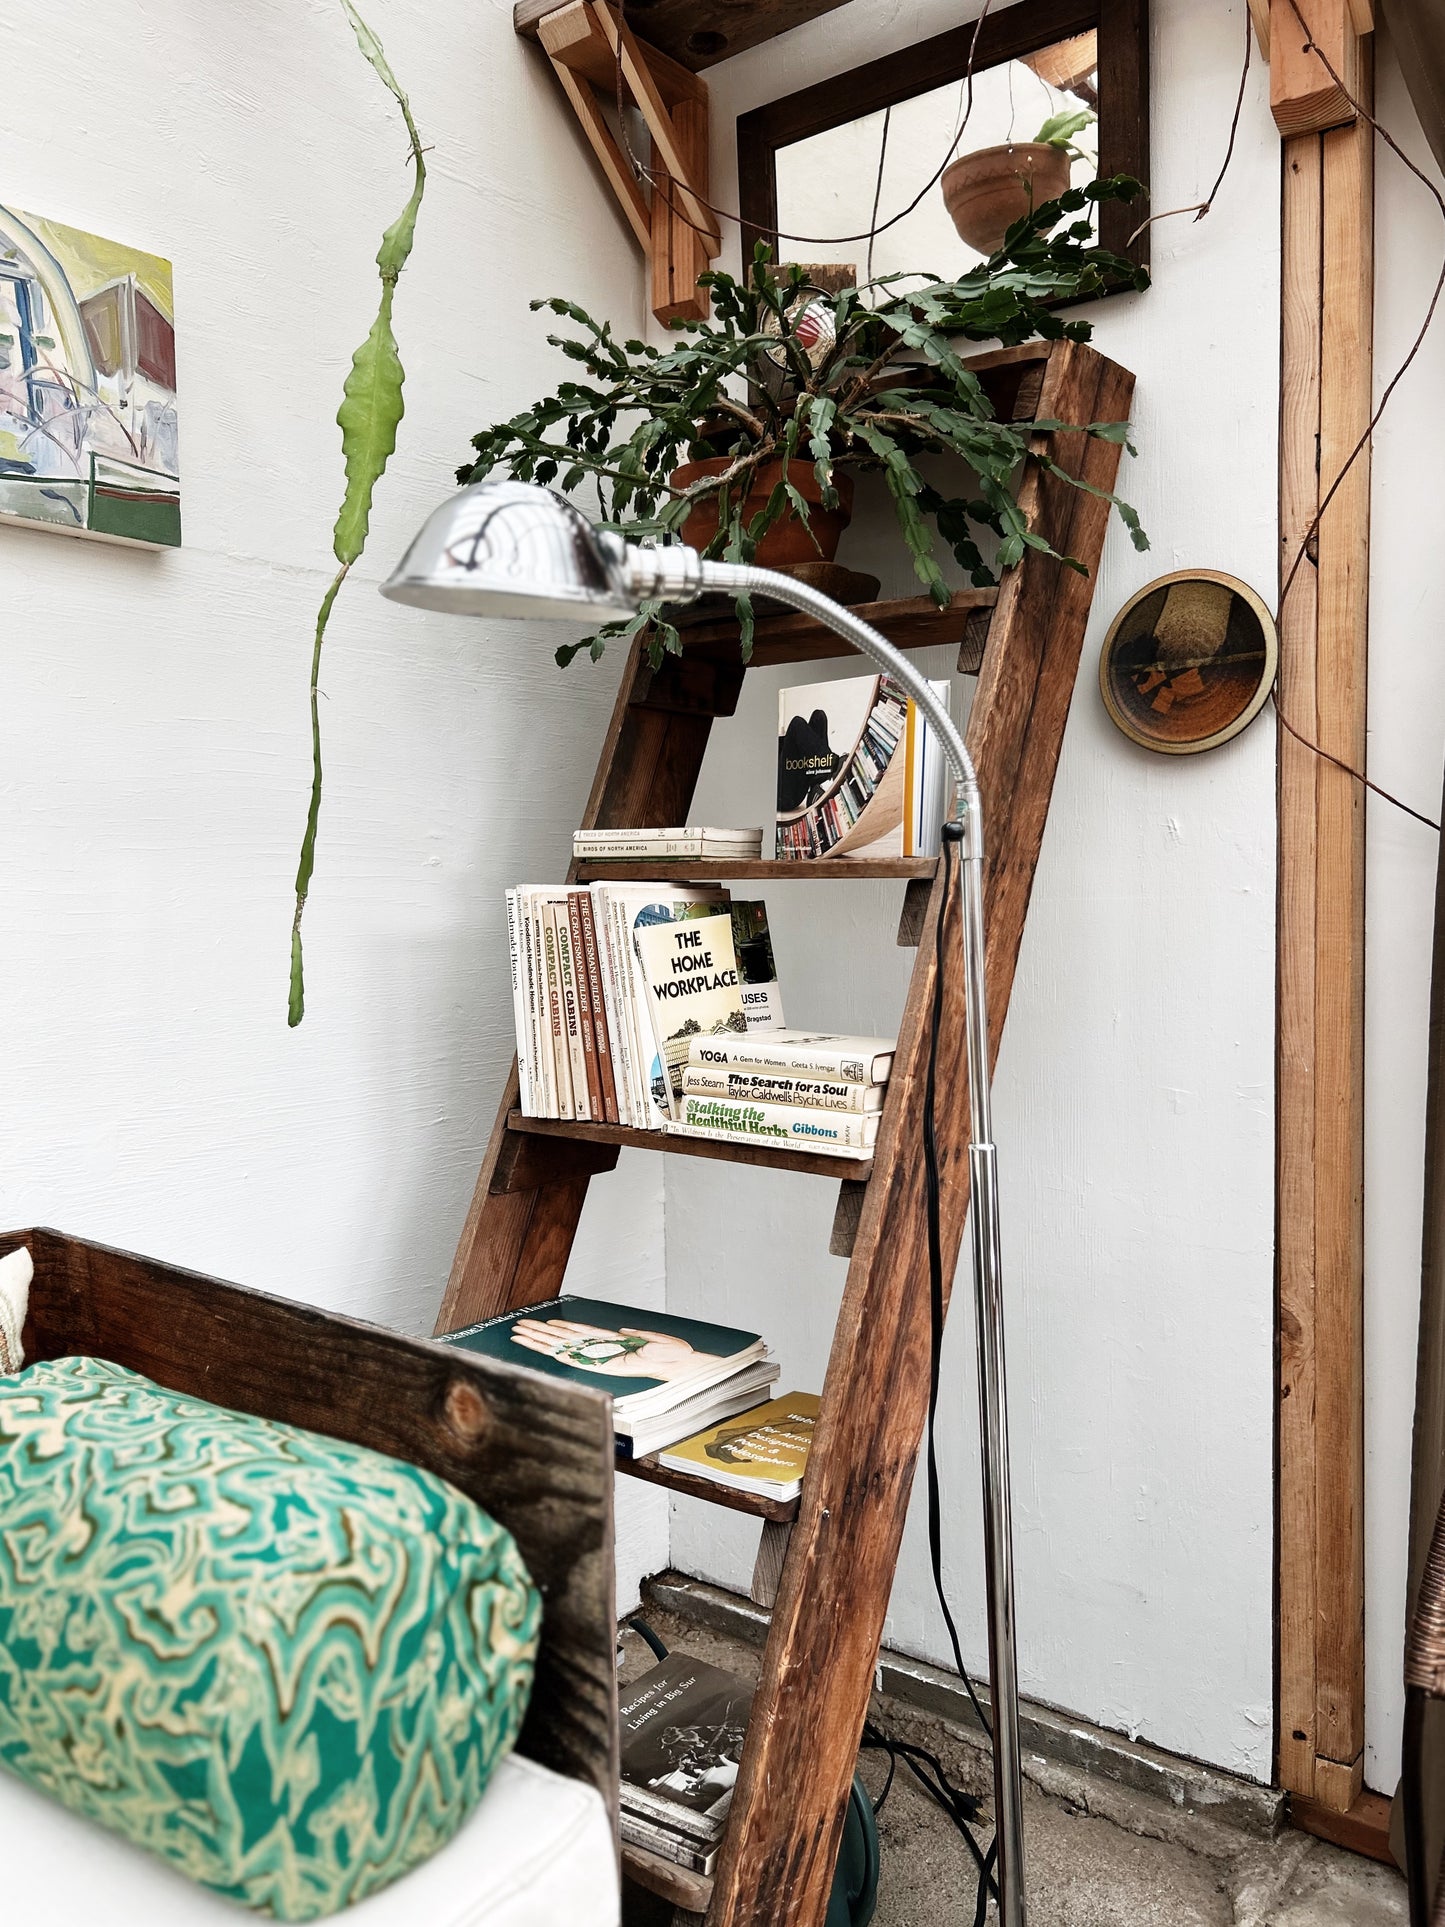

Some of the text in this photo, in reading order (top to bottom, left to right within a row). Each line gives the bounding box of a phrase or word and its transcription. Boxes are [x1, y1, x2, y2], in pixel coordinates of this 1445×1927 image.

[786, 753, 833, 770] bookshelf
[581, 897, 590, 917] THE
[507, 897, 517, 952] Handmade
[524, 916, 532, 953] Woodstock
[584, 917, 597, 974] CRAFTSMAN
[674, 930, 702, 950] THE
[569, 897, 587, 1013] THE CRAFTSMAN BUILDER
[670, 951, 714, 974] HOME
[527, 953, 535, 990] Handmade
[545, 926, 561, 1037] COMPACT CABINS
[560, 926, 572, 987] COMPACT
[566, 990, 577, 1037] CABINS
[590, 975, 601, 1014] BUILDER
[653, 970, 738, 1001] WORKPLACE
[741, 992, 768, 1004] USES
[746, 1014, 771, 1022] Bragstad
[700, 1050, 728, 1063] YOGA
[764, 1059, 787, 1067] Women
[791, 1061, 808, 1069] Geeta
[815, 1064, 836, 1073] Iyengar
[687, 1076, 725, 1089] Jess Stearn
[728, 1074, 848, 1097] The Search for a Soul
[727, 1084, 848, 1110] Taylor Caldwell's Psychic Lives
[687, 1099, 766, 1122] Stalking the
[686, 1113, 789, 1138] Healthful Herbs
[792, 1122, 838, 1139] Gibbons
[727, 1132, 761, 1144] Preservation
[771, 1139, 780, 1147] the
[721, 1444, 797, 1467] Philosophers
[734, 1438, 767, 1451] Poets
[620, 1680, 668, 1715] Recipes for
[627, 1676, 696, 1730] Living in Big Sur
